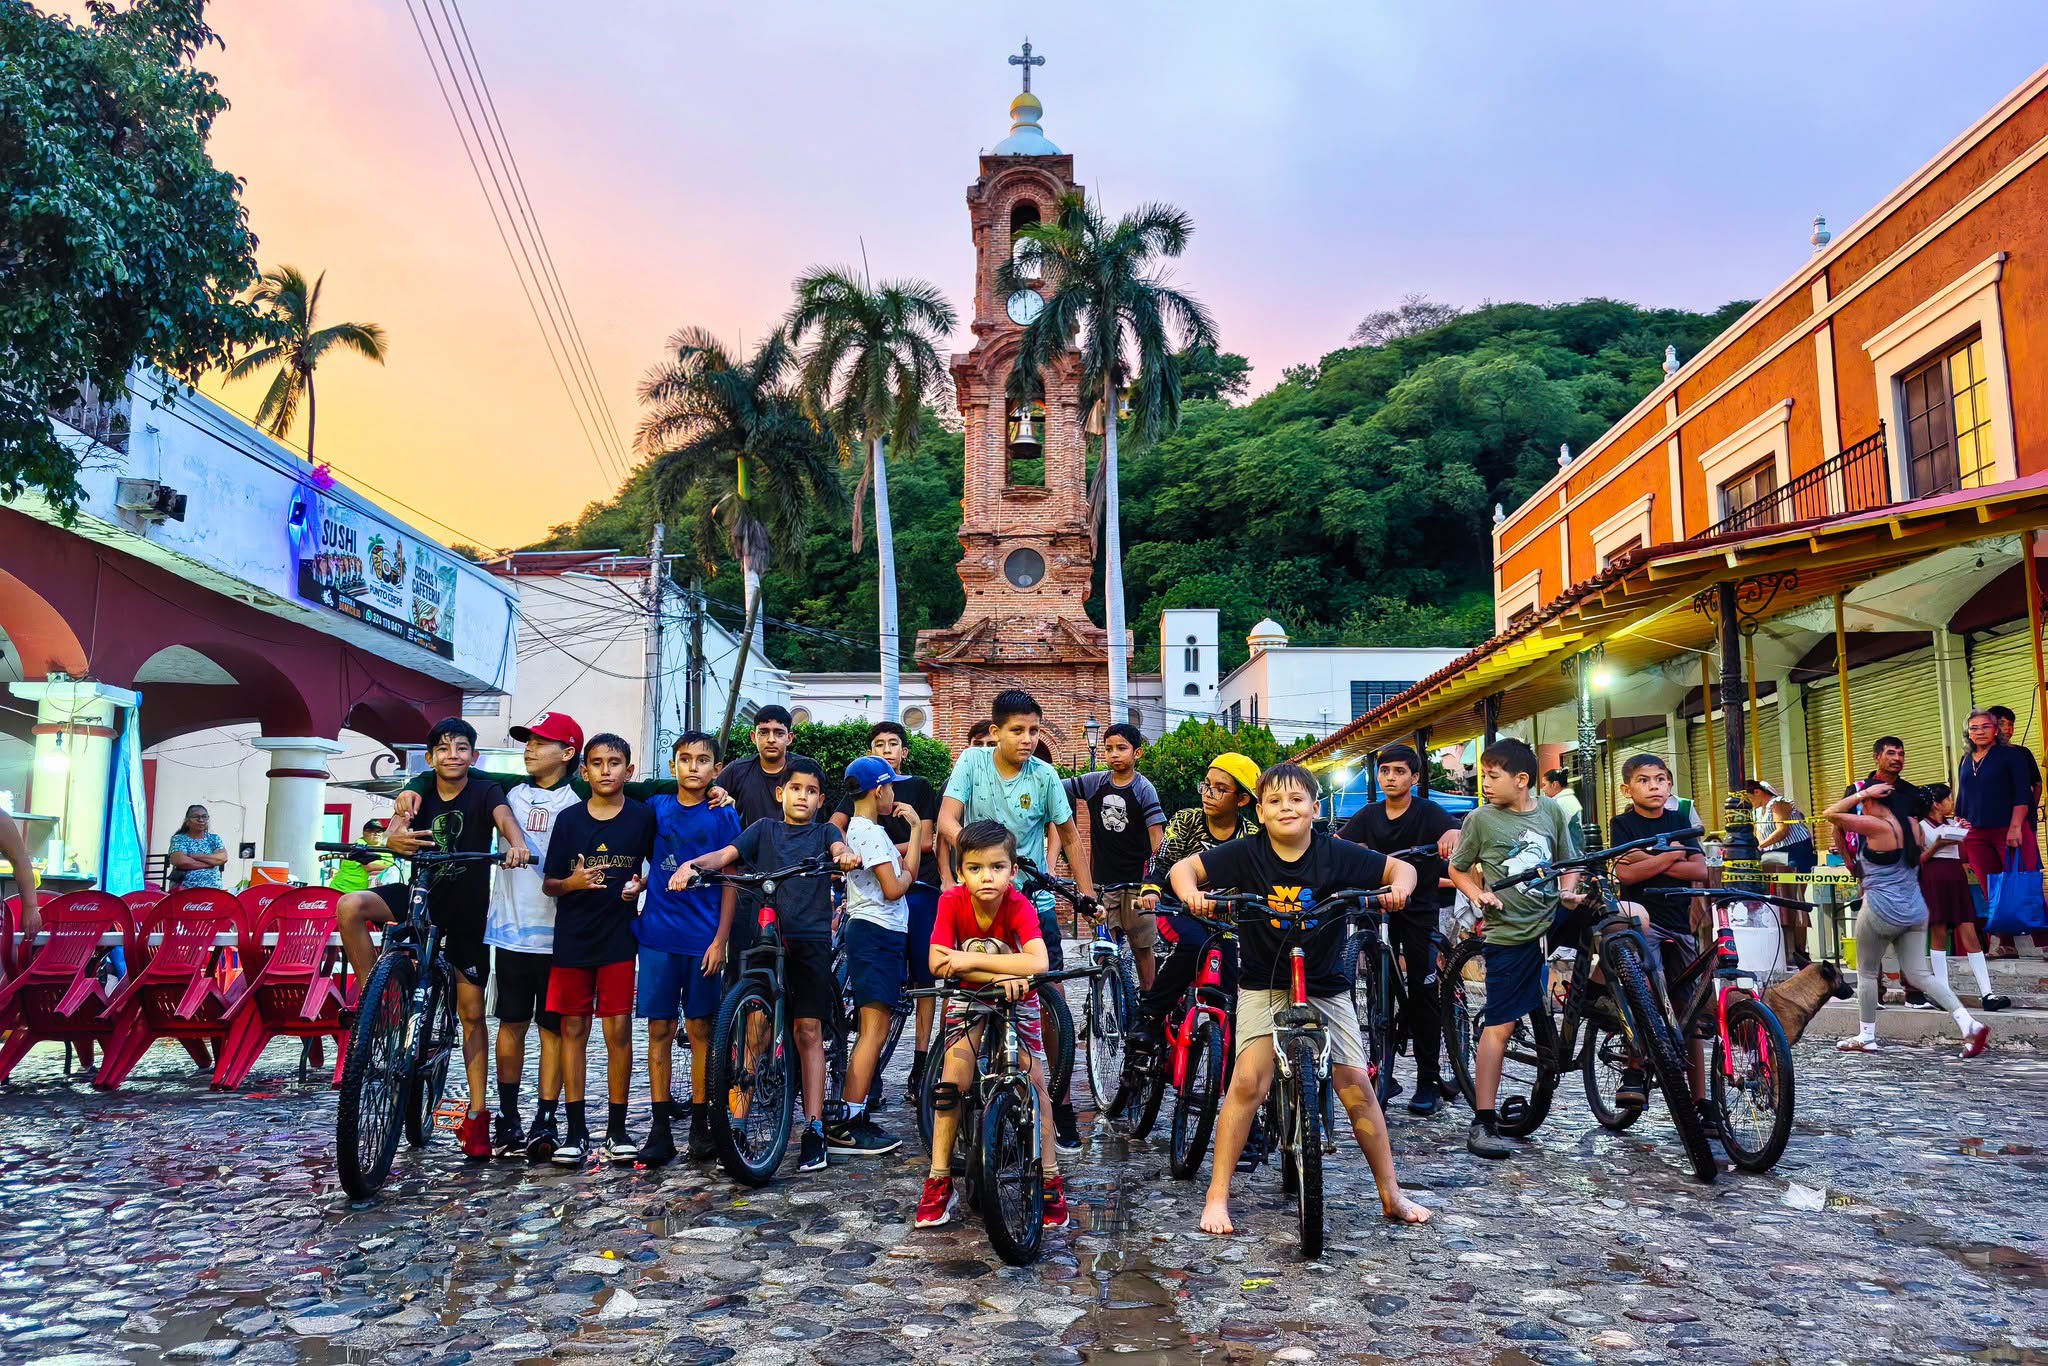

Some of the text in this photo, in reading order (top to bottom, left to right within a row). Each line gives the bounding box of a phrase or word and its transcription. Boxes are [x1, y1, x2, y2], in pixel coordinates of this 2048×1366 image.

[321, 519, 357, 554] SUSHI
[415, 565, 434, 586] CREPAS
[370, 584, 387, 599] PUNTO
[372, 612, 382, 625] 324
[586, 855, 635, 868] GALAXY
[1722, 872, 1857, 883] ECAUCIÓN PRECAUC
[183, 902, 214, 911] Coca-Cola
[298, 900, 328, 910] Coca-Cola
